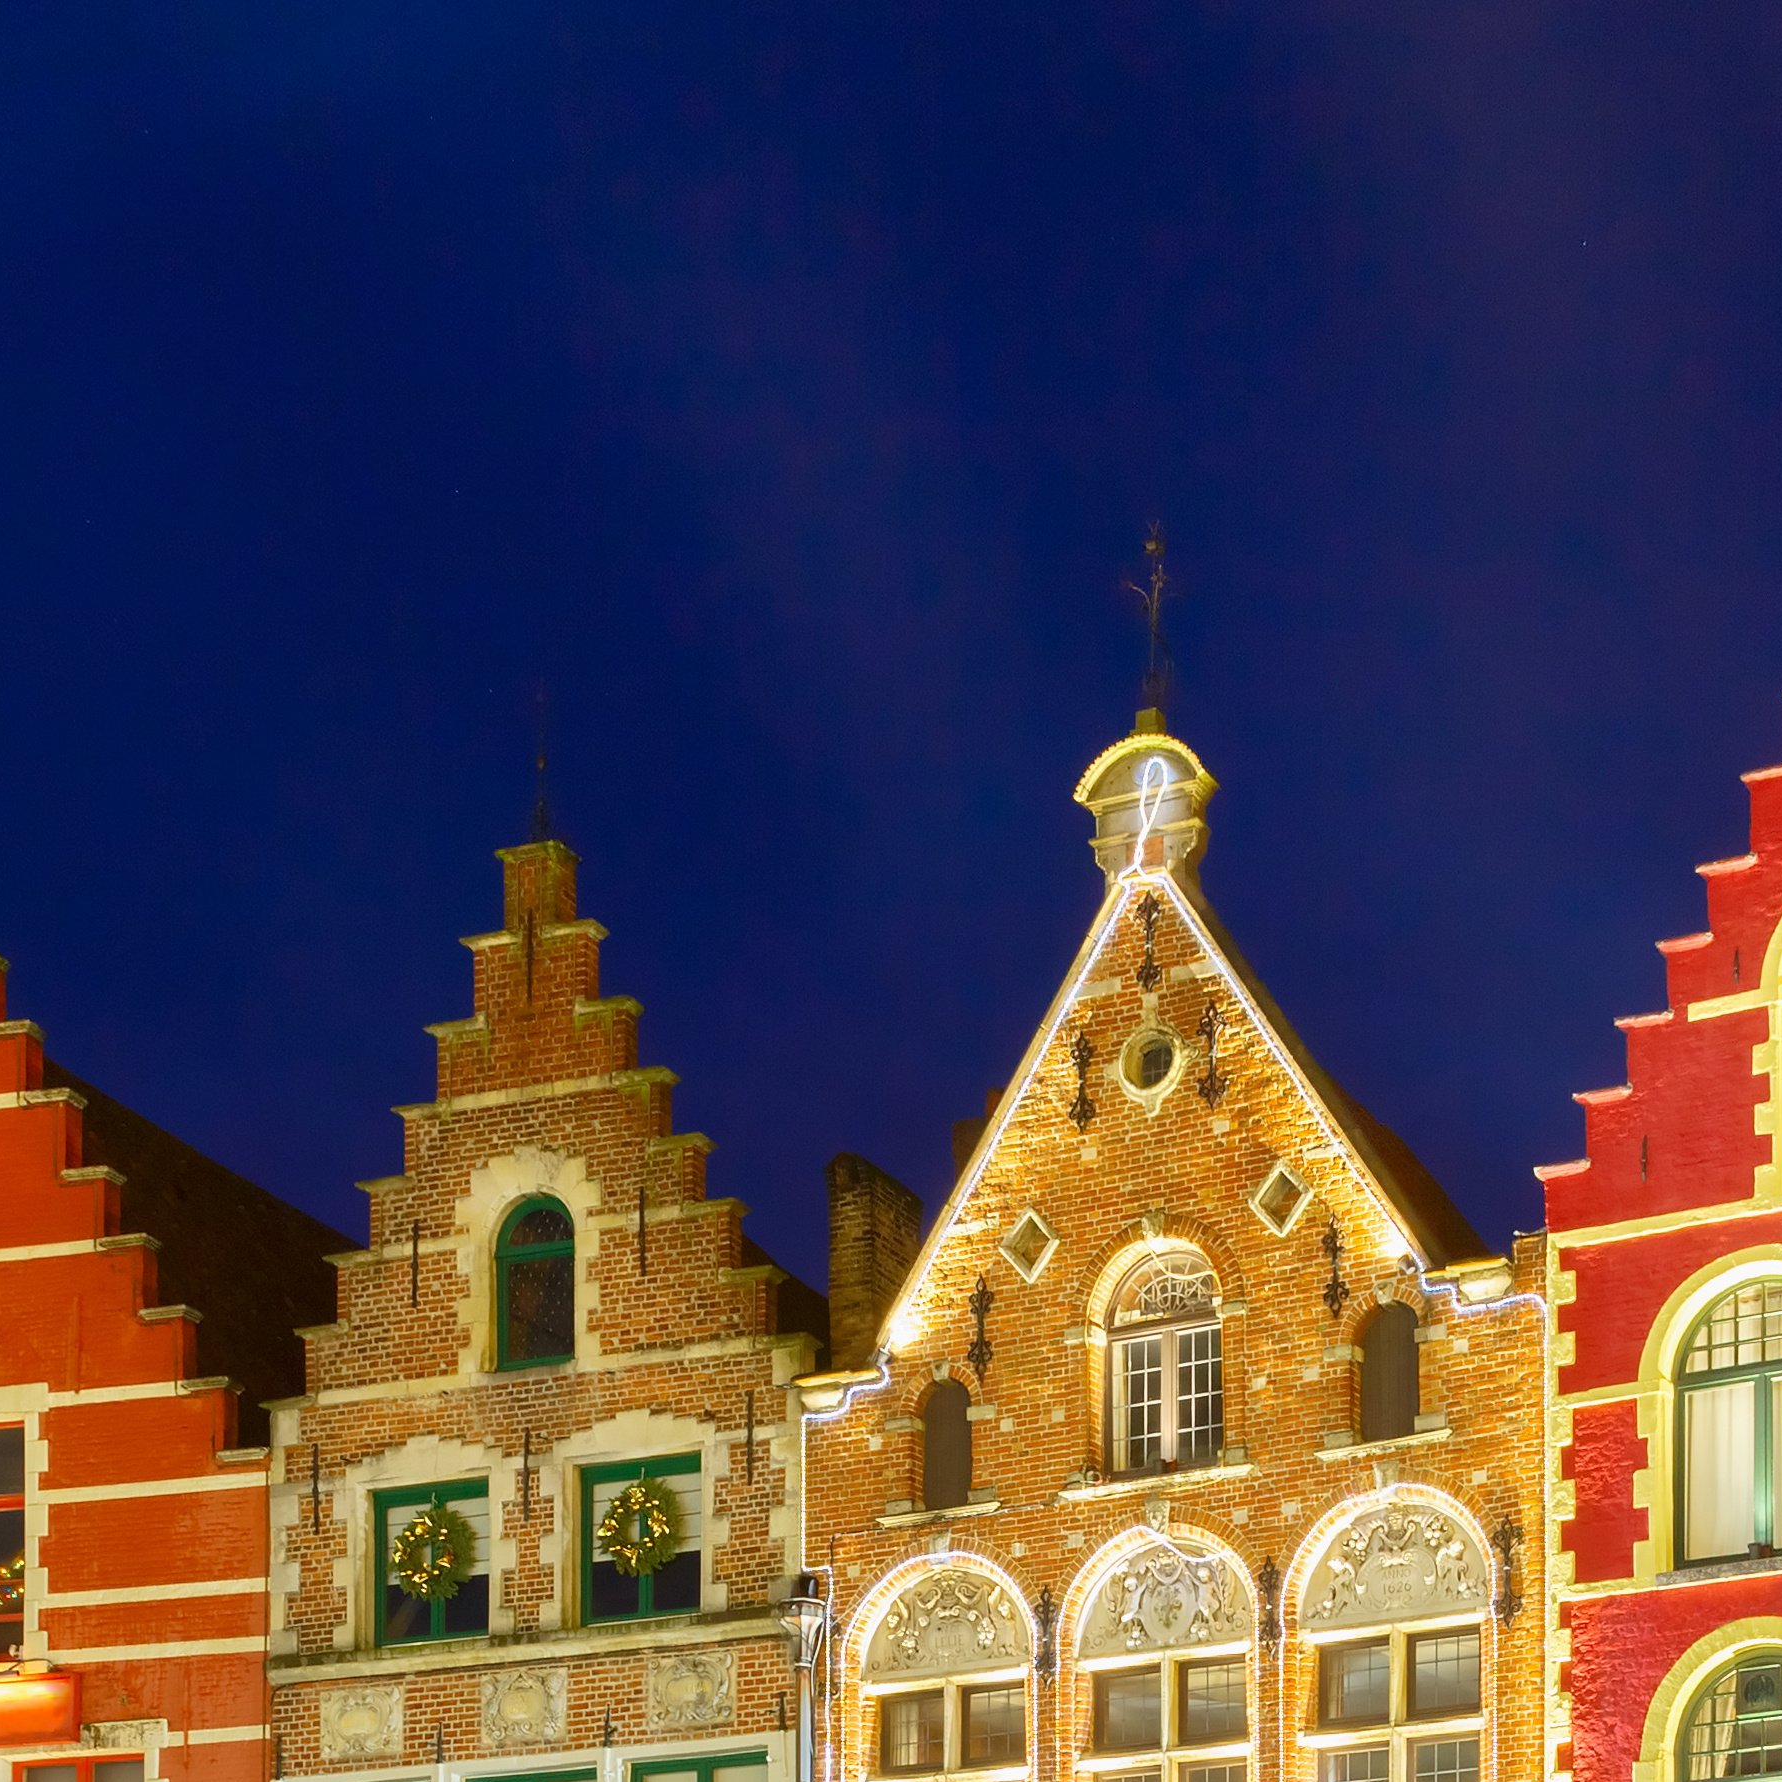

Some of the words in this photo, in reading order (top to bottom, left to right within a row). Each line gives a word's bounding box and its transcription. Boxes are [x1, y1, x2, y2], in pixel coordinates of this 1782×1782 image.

[1380, 1568, 1412, 1581] ANNO
[1382, 1580, 1412, 1595] 1626
[935, 1634, 964, 1648] LELIE
